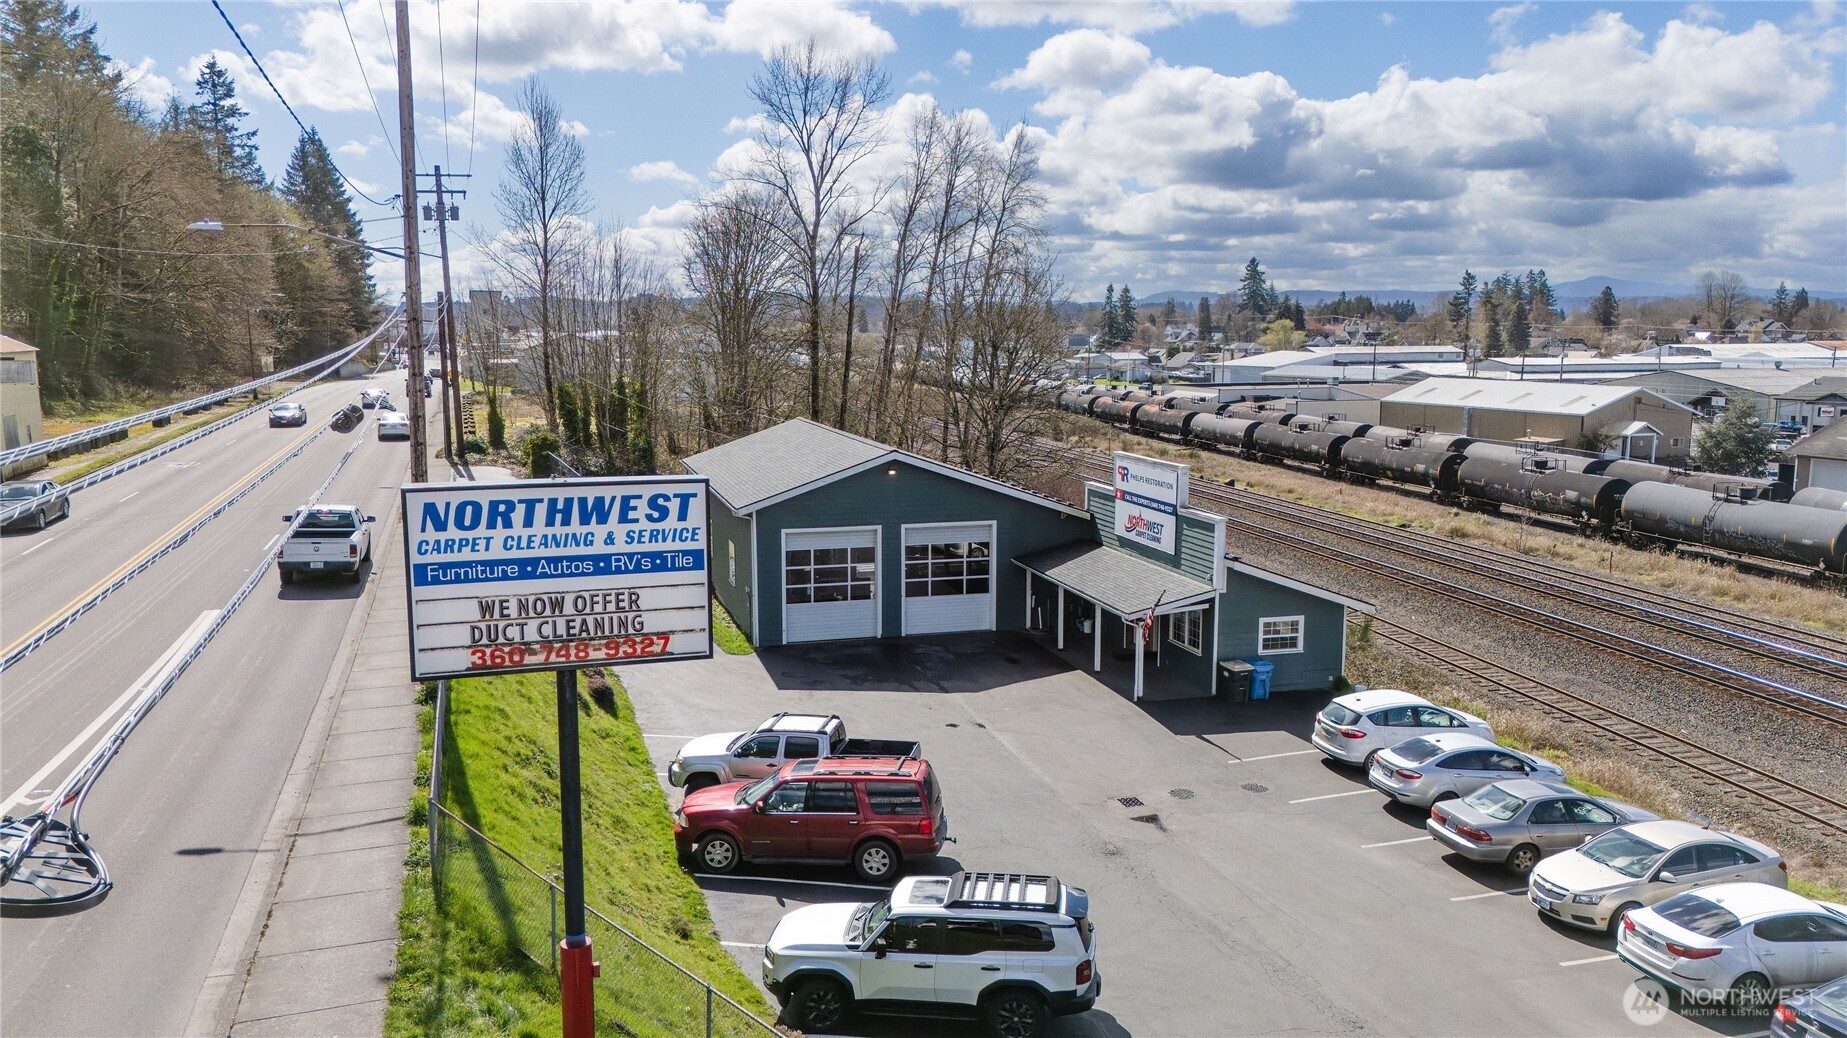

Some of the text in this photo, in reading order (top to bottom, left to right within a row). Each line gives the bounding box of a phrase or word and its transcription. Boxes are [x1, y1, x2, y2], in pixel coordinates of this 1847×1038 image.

[1130, 473, 1174, 490] PHELPS RESTORATION
[420, 492, 698, 533] NORTHWEST
[1127, 514, 1164, 536] NORTHWEST
[416, 527, 702, 556] CARPET CLEANING & SERVICE
[1135, 529, 1162, 544] CARPET CLEANING
[427, 552, 694, 582] Furniture Autos RV's Tile
[477, 591, 641, 619] WE NOW OFFER
[469, 614, 645, 644] DUCT CLEANING
[469, 635, 672, 669] 360-748-9327
